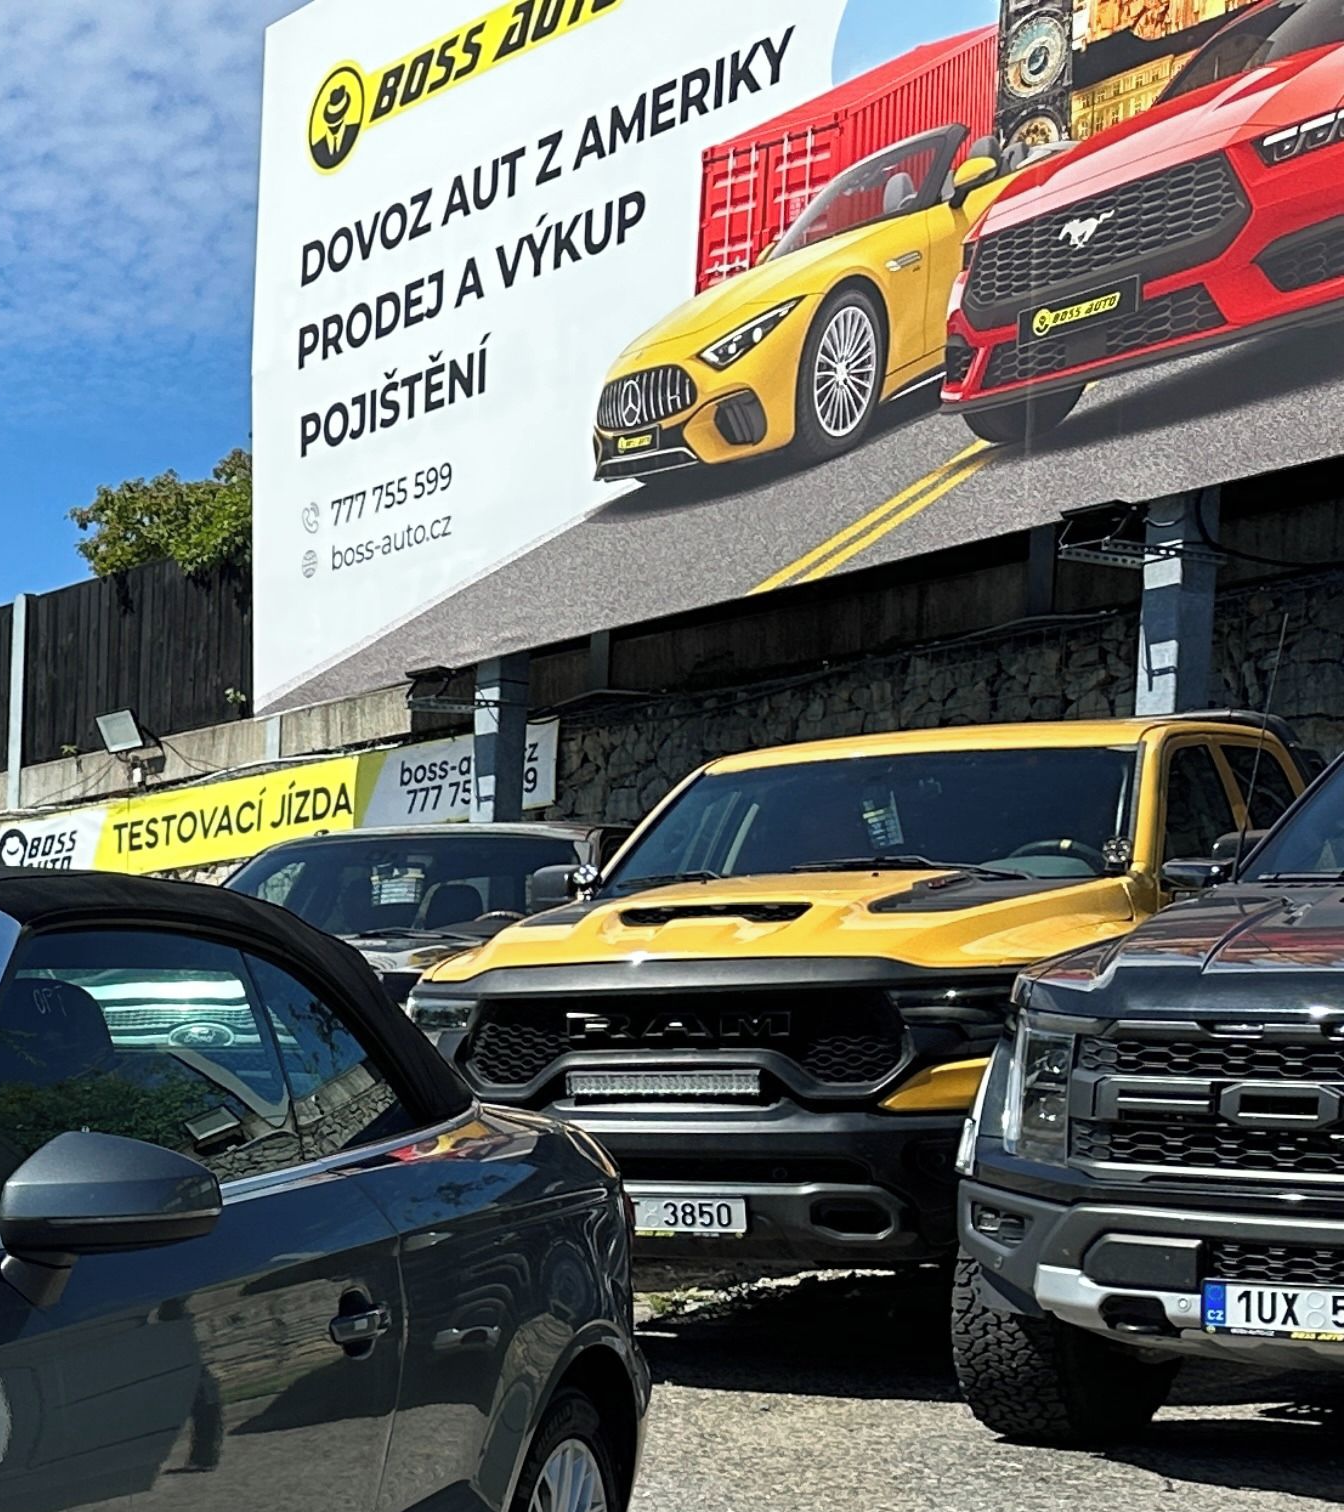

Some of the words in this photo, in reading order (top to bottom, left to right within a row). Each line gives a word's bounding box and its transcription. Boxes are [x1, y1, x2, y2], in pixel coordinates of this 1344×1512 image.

[369, 20, 487, 123] BOSS
[300, 188, 434, 287] DOVOZ
[440, 146, 528, 229] AUT
[534, 129, 563, 186] Z
[573, 24, 797, 170] AMERIKY
[297, 278, 445, 369] PRODEJ
[454, 256, 485, 307] A
[498, 190, 647, 289] VÝKUP
[299, 331, 492, 457] POJIŠTĚNÍ
[331, 490, 367, 526] 777
[372, 476, 408, 513] 755
[413, 462, 452, 499] 599
[332, 515, 452, 571] boss-auto.cz
[113, 786, 267, 854] TESTOVACÍ
[270, 780, 353, 829] JÍZDA
[406, 785, 442, 814] 777
[449, 780, 472, 807] 75
[28, 830, 77, 859] BOSS
[566, 1011, 791, 1039] RAM
[664, 1202, 732, 1228] 3850
[1207, 1309, 1224, 1321] CZ
[1237, 1290, 1300, 1326] 1UX
